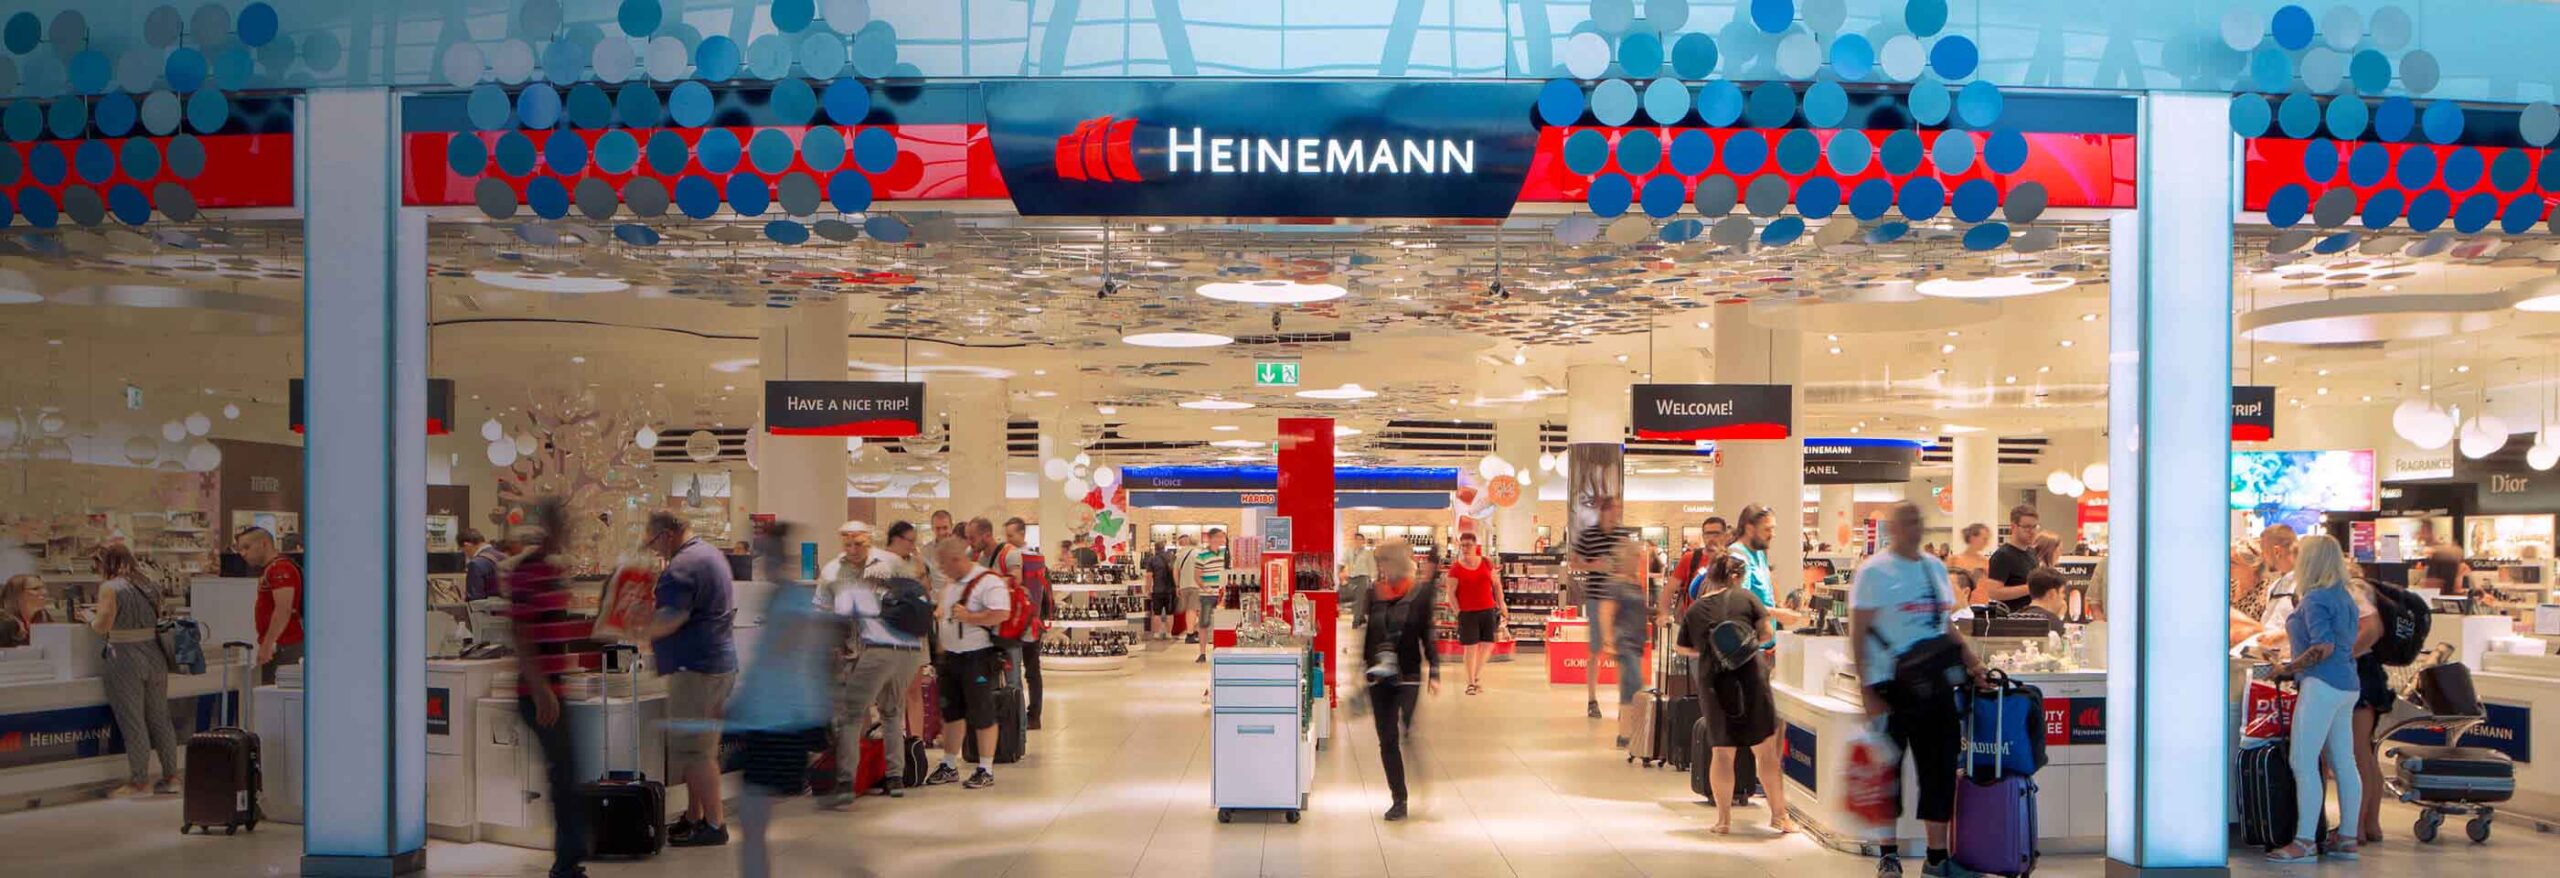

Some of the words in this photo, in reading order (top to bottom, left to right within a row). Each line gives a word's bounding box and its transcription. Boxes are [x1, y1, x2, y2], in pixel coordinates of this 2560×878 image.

[1168, 127, 1474, 173] HEINEMANN
[788, 396, 824, 411] HAVE
[828, 399, 838, 411] A
[842, 399, 871, 411] NICE
[875, 396, 910, 411] TRIP!
[1656, 399, 1733, 416] WELCOME!
[1803, 446, 1852, 454] EINEMANN
[2490, 473, 2529, 494] Dior
[1240, 493, 1275, 505] HARIBO
[29, 726, 112, 748] HEINEMANN
